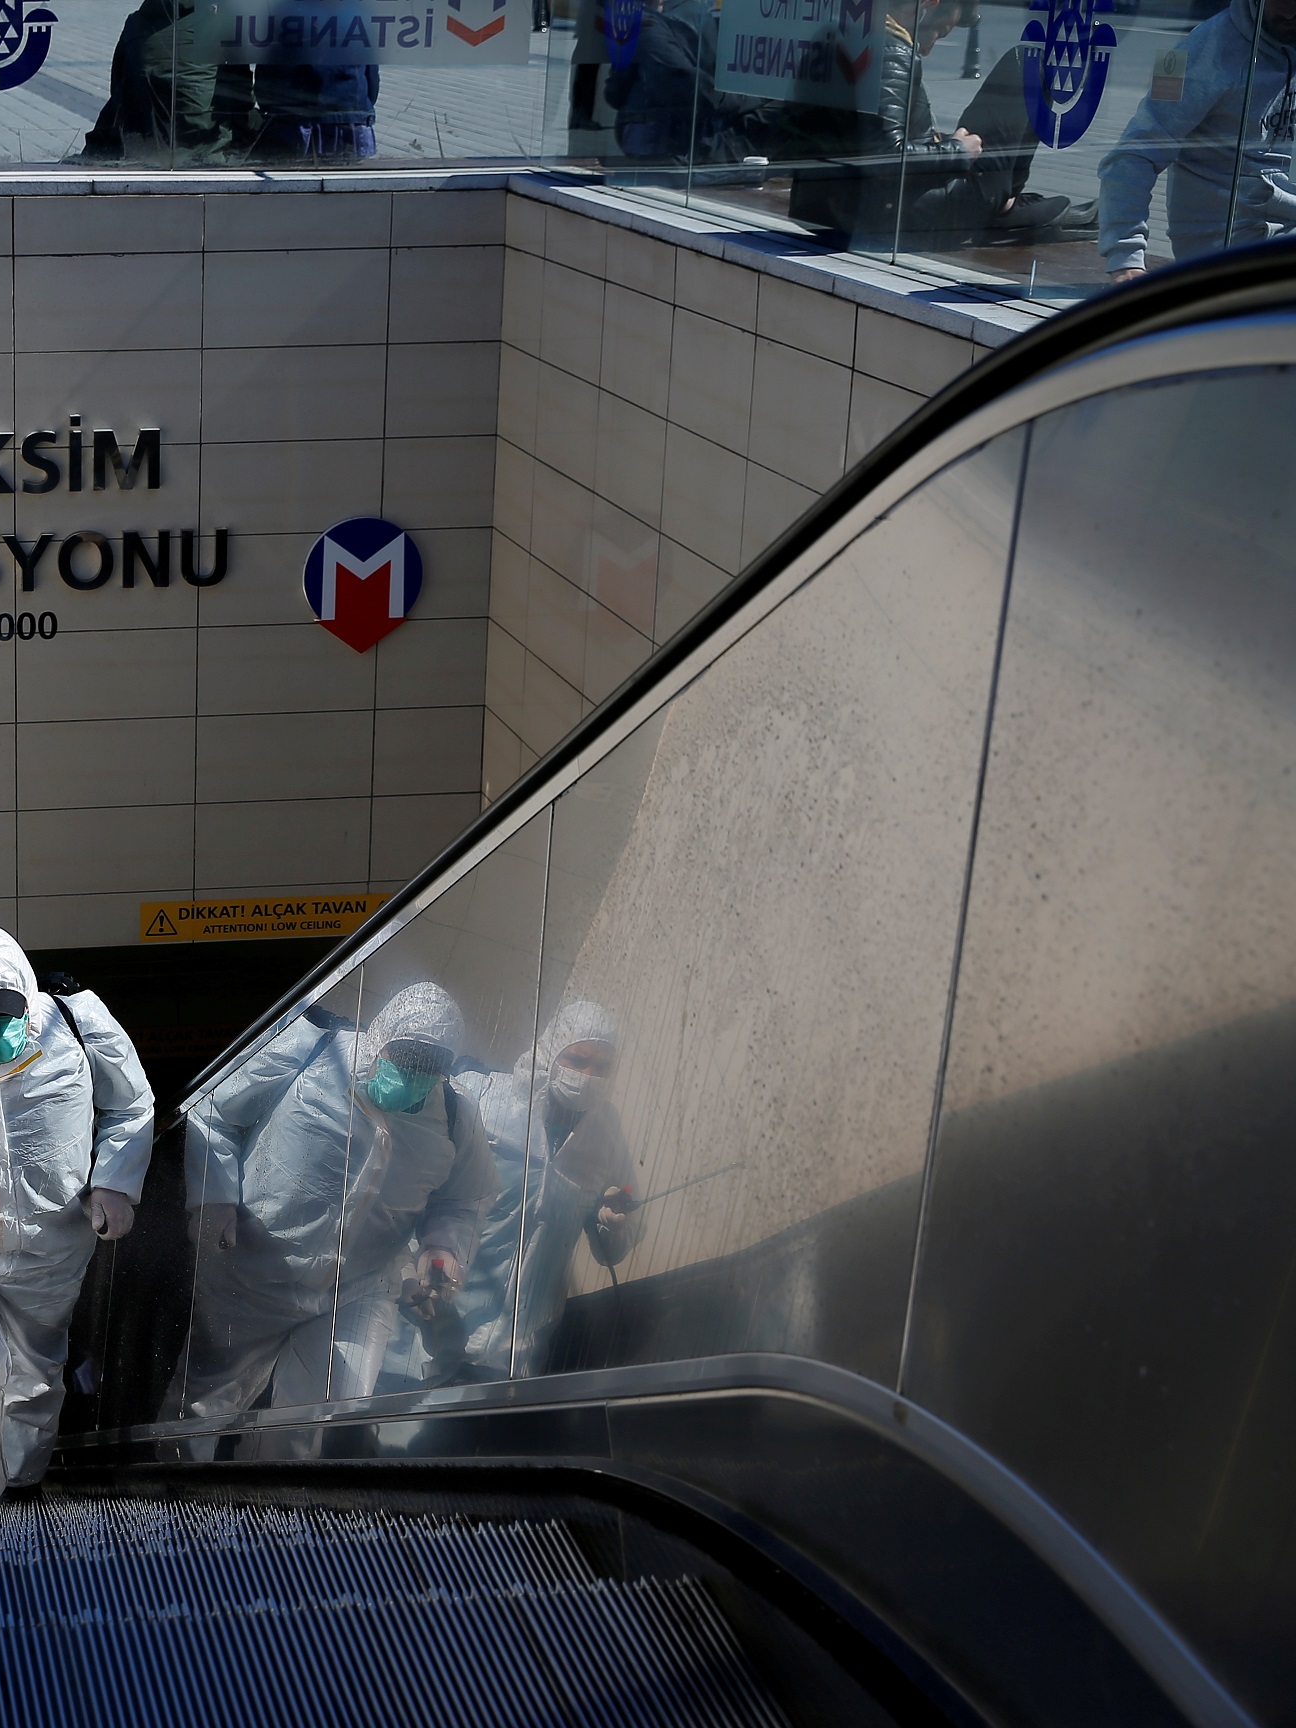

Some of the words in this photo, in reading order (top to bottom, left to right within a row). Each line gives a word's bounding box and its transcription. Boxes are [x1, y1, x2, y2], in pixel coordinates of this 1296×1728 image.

[177, 903, 246, 921] DİKKAT!
[251, 901, 308, 922] ALÇAK
[312, 899, 368, 915] TAVAN
[202, 920, 268, 935] ATTENTION!
[271, 920, 297, 932] LOW
[300, 919, 342, 931] CEILING
